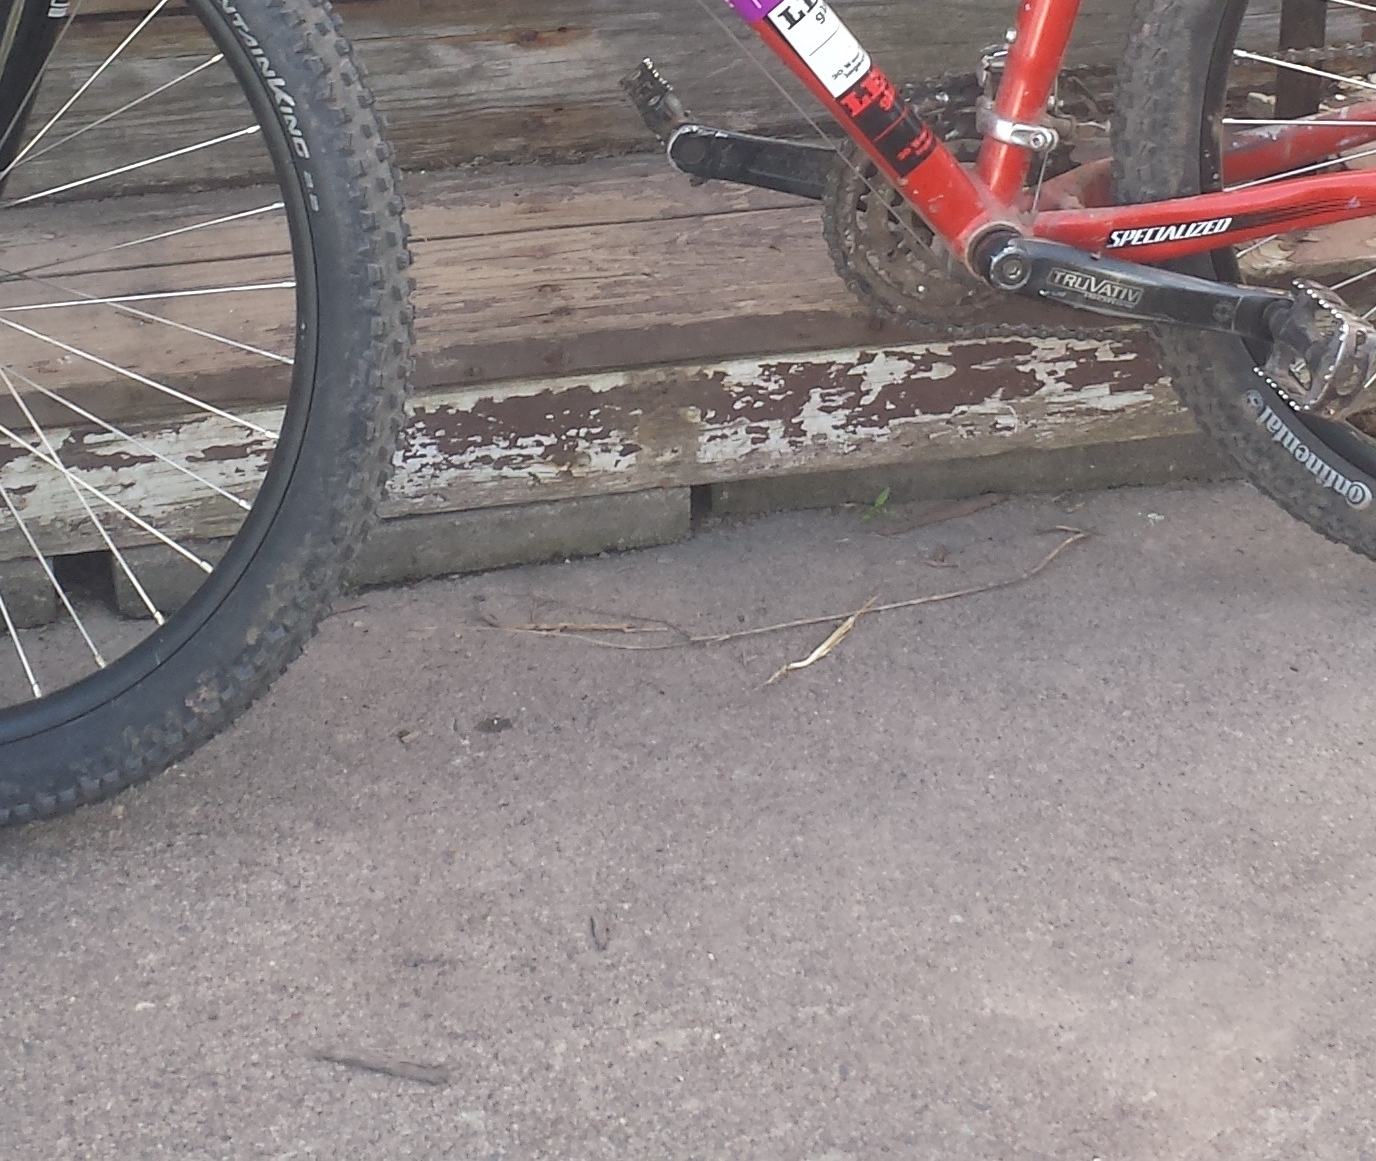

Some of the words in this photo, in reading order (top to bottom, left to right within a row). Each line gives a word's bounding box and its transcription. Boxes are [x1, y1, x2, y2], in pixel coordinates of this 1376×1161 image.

[1106, 217, 1234, 250] SPECIALIZED
[1050, 269, 1141, 304] TRUVATIV
[1258, 405, 1373, 510] Continental
